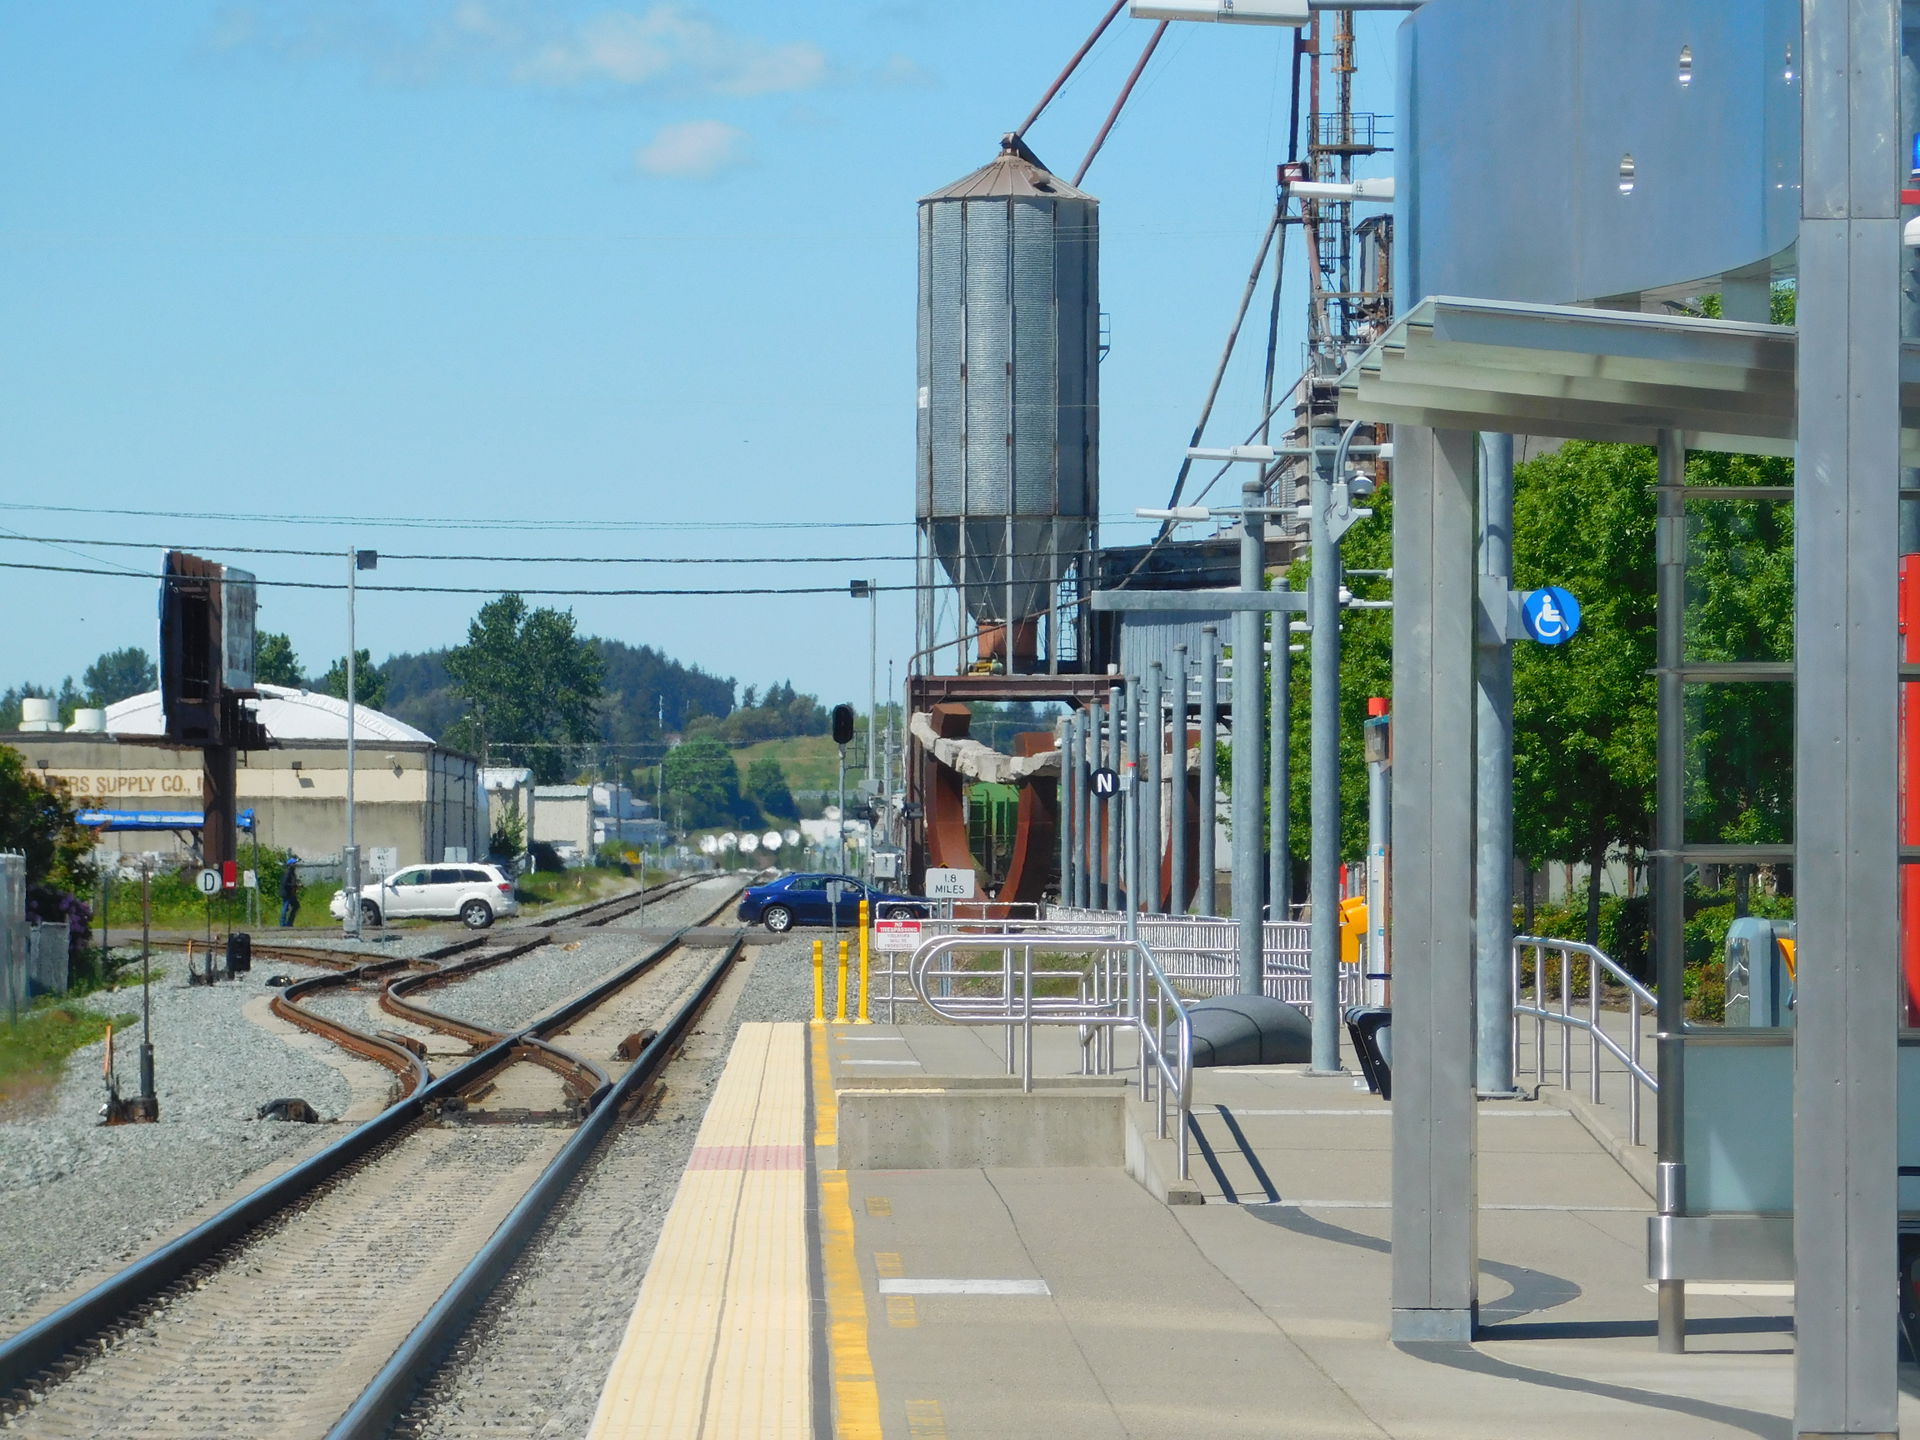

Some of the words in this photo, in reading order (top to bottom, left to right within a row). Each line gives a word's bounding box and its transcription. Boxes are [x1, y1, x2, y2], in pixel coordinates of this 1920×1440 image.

[96, 776, 155, 793] SUPPLY
[1097, 773, 1112, 793] N
[204, 872, 215, 891] D
[944, 873, 957, 883] 1.8
[935, 885, 965, 894] MILES
